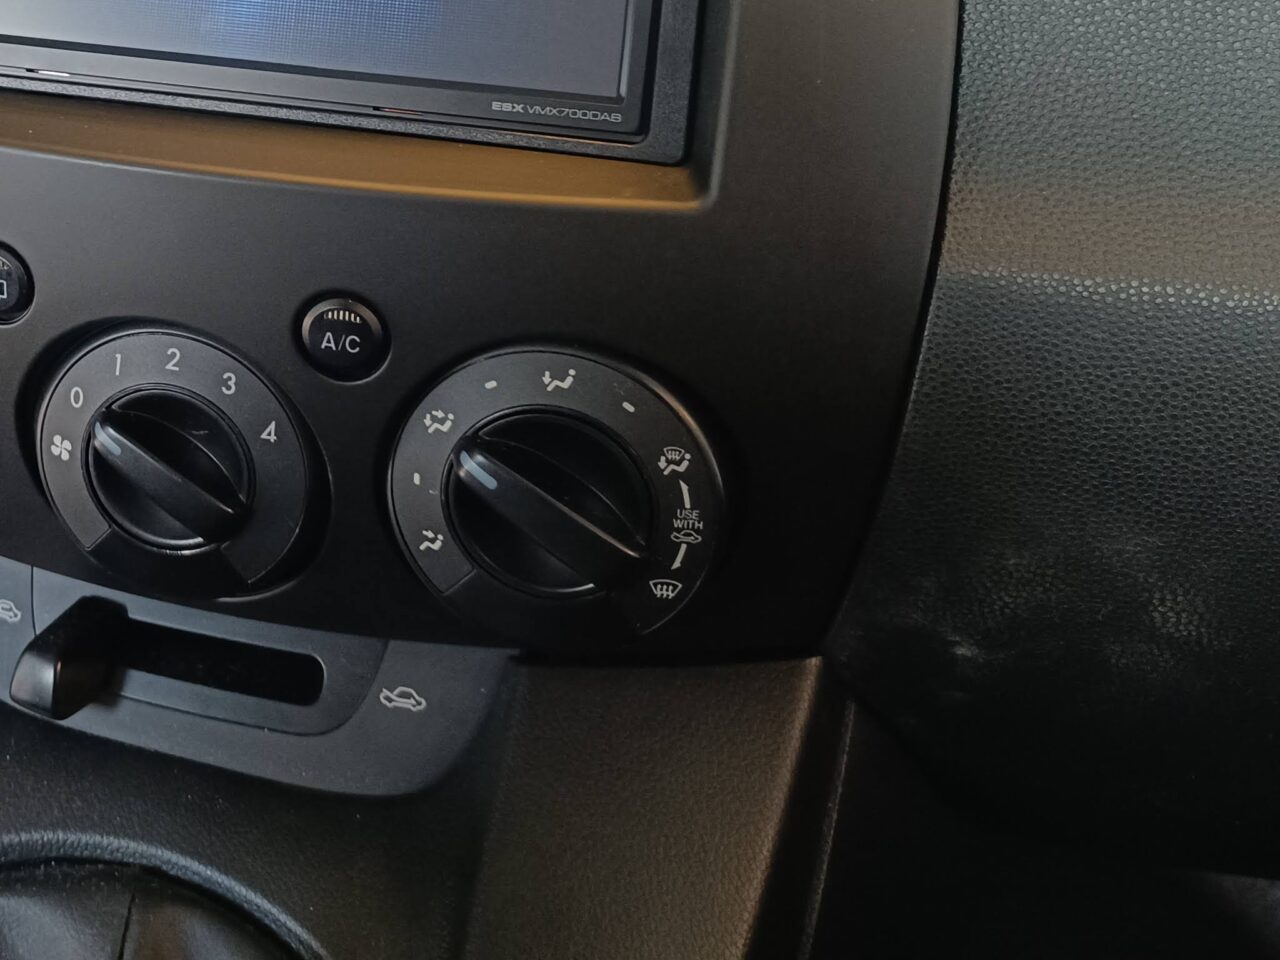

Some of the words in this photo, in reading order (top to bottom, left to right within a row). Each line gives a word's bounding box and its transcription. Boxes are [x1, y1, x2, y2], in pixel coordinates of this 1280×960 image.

[491, 101, 524, 113] ESX
[320, 331, 361, 353] A/C
[114, 353, 122, 376] 1
[165, 348, 181, 371] 2
[221, 372, 237, 395] 3
[70, 386, 84, 409] 0
[260, 420, 278, 444] 4
[672, 518, 704, 530] WITH
[676, 509, 700, 520] USE
